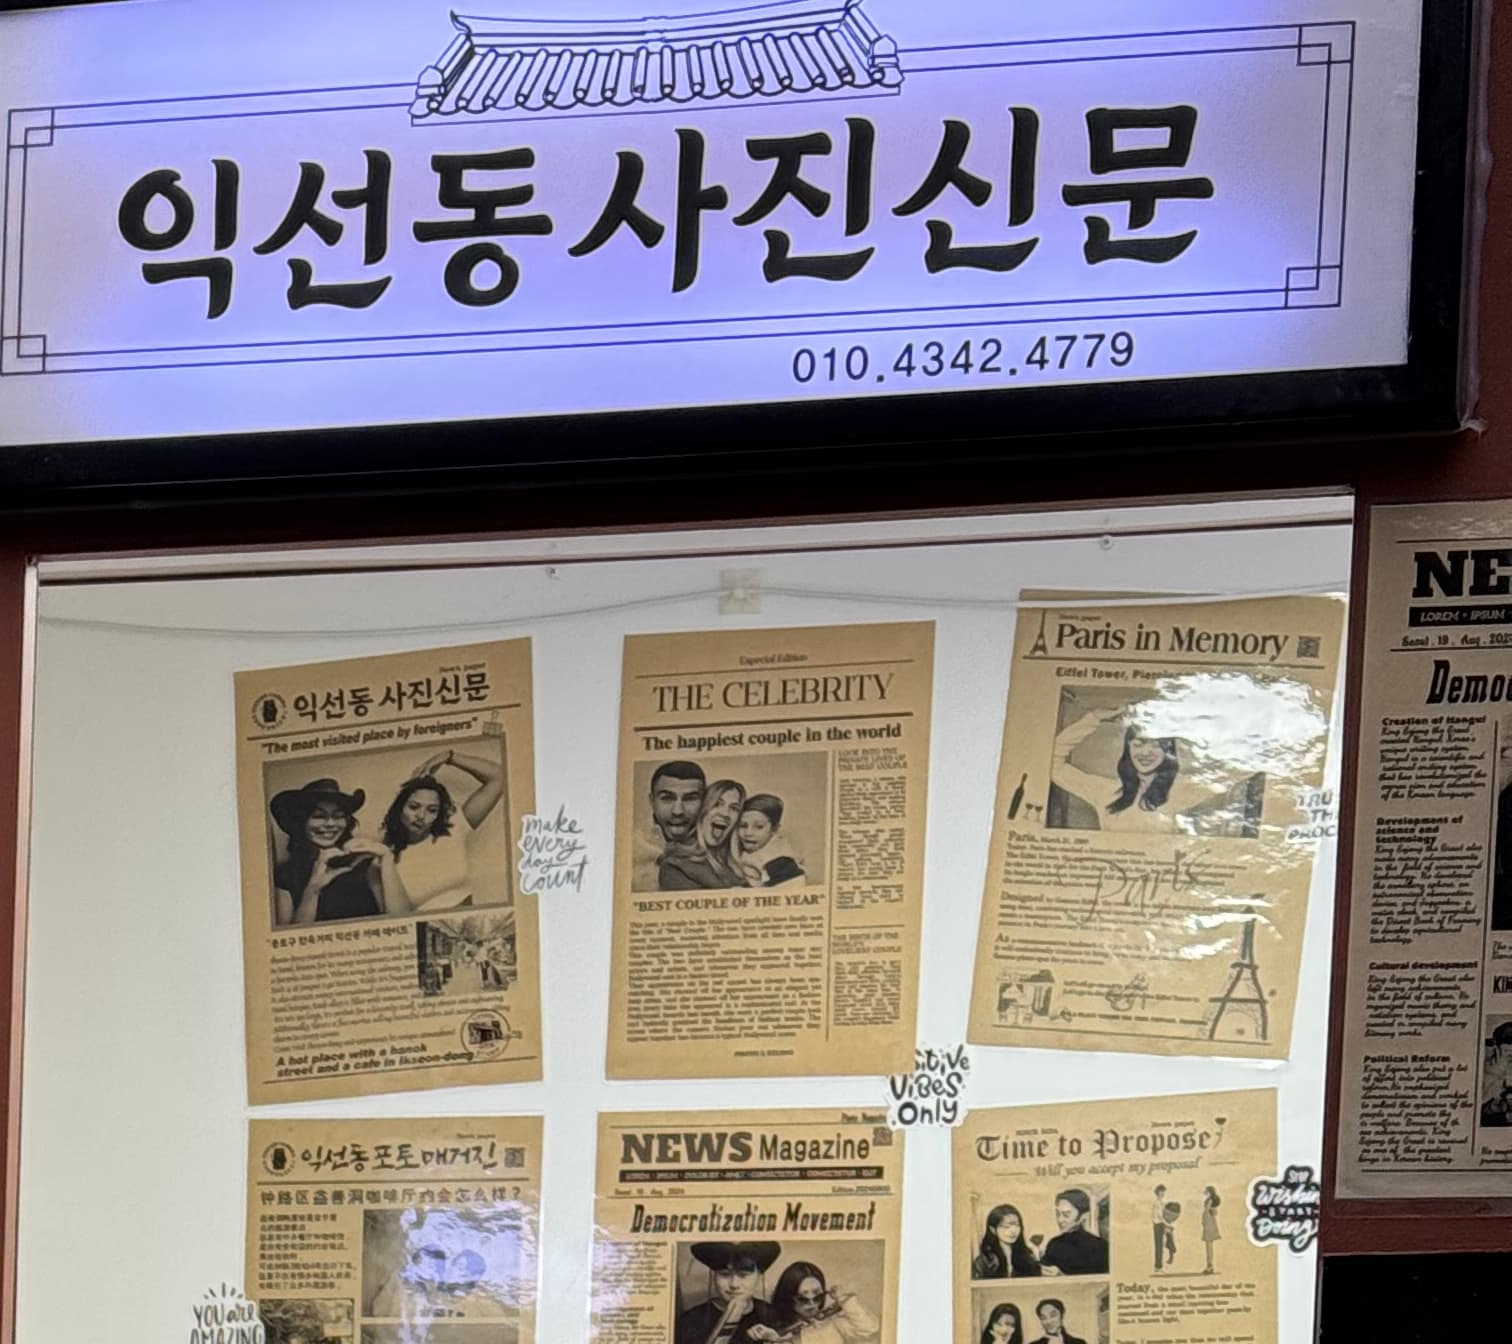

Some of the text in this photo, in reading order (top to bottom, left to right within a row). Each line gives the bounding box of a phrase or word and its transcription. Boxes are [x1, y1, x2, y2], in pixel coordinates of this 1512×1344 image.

[116, 104, 1216, 321] 익선동사진신문
[791, 329, 1138, 388] 010.4342.4779
[1420, 609, 1506, 622] LOREM IPSUM
[1054, 621, 1289, 662] Paris in Memory
[1055, 666, 1129, 681] Eiffel Tower,
[1426, 659, 1512, 704] Demo
[293, 672, 491, 723] 익선동 사진신문
[652, 672, 895, 714] THE CELEBRITY
[260, 716, 479, 756] "The most visited place by foreigners"
[641, 722, 901, 752] The happiest couple in the world
[526, 803, 584, 834] make
[523, 858, 589, 894] count
[898, 1098, 958, 1125] Only
[620, 1131, 870, 1164] NEWS Magazine
[974, 1135, 1049, 1162] Time
[1058, 1134, 1082, 1158] to
[630, 1200, 876, 1234] Democratization Movement
